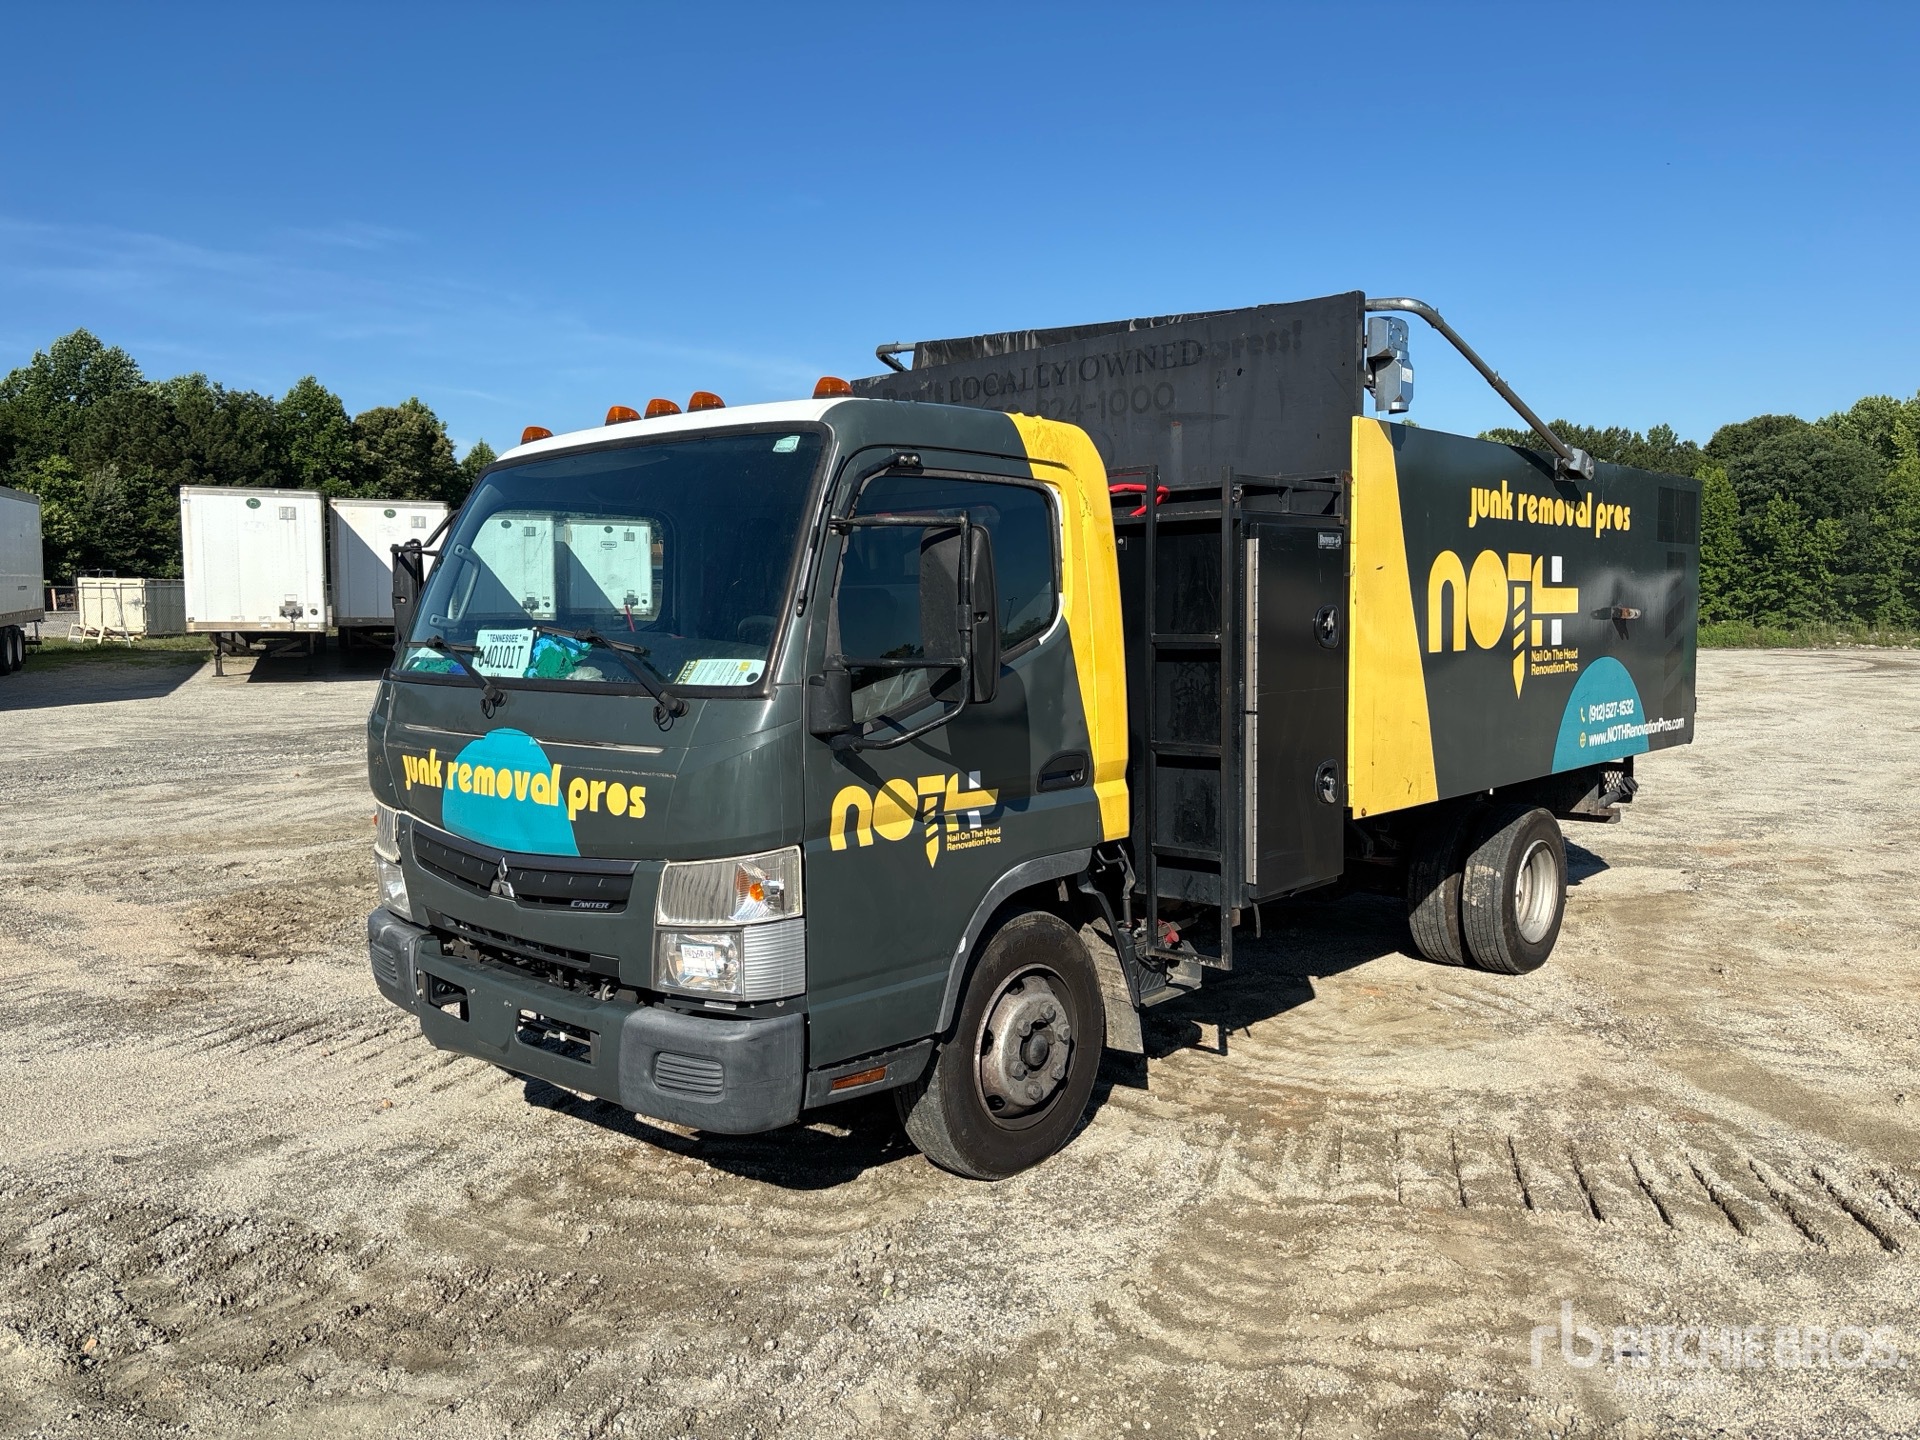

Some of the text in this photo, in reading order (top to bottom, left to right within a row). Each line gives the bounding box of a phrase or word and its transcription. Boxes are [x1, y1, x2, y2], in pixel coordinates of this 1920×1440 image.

[949, 338, 1204, 403] LOCALLY OWNED
[1468, 480, 1631, 538] junk removal pros
[1531, 647, 1578, 662] Nail On The Head
[1531, 660, 1578, 676] Renovation Pros
[1588, 699, 1634, 723] (912) 527-1532
[1588, 717, 1685, 747] www.NOTHRenovationPros.com
[401, 748, 647, 821] junk removal pros
[946, 826, 1002, 842] Nail On The Head
[946, 835, 1002, 852] Renovation Pros
